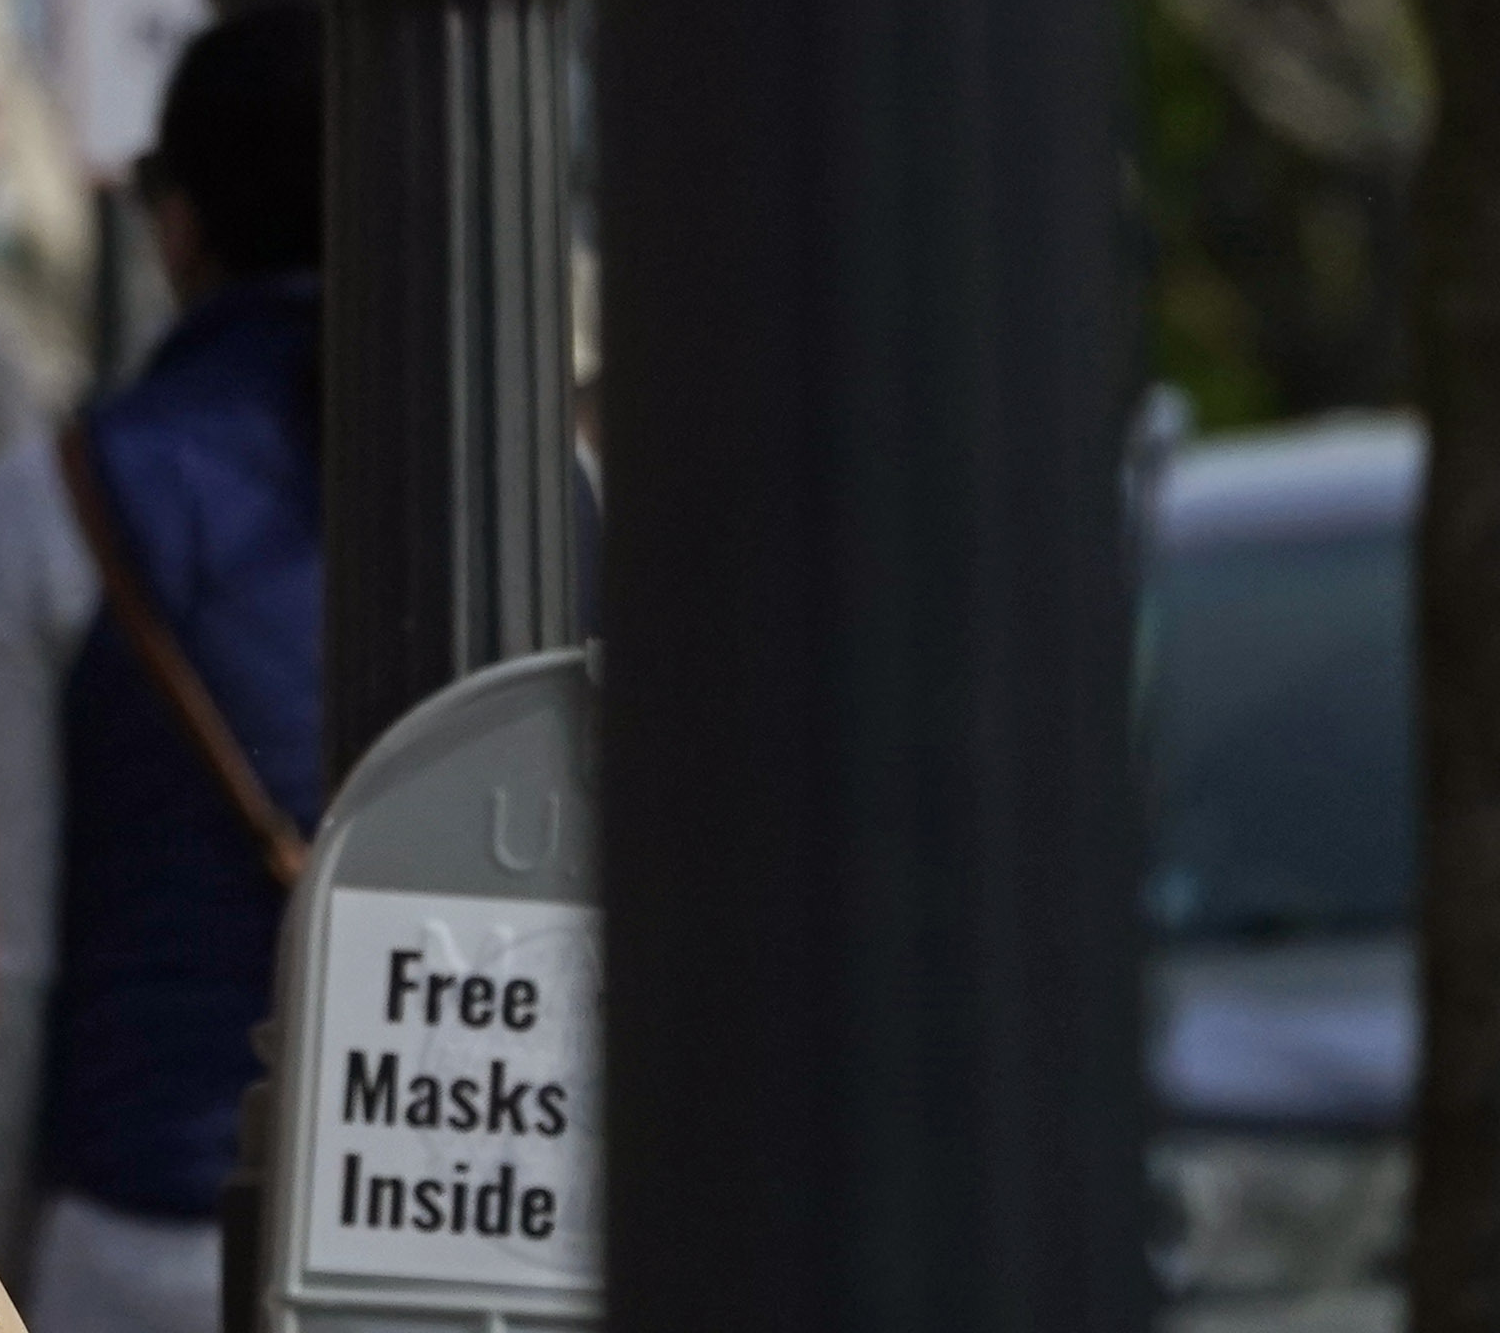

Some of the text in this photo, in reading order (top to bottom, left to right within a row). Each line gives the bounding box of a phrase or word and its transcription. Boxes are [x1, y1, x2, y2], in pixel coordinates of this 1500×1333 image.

[386, 947, 538, 1031] Free
[342, 1050, 568, 1138] Masks
[340, 1153, 556, 1241] Inside
